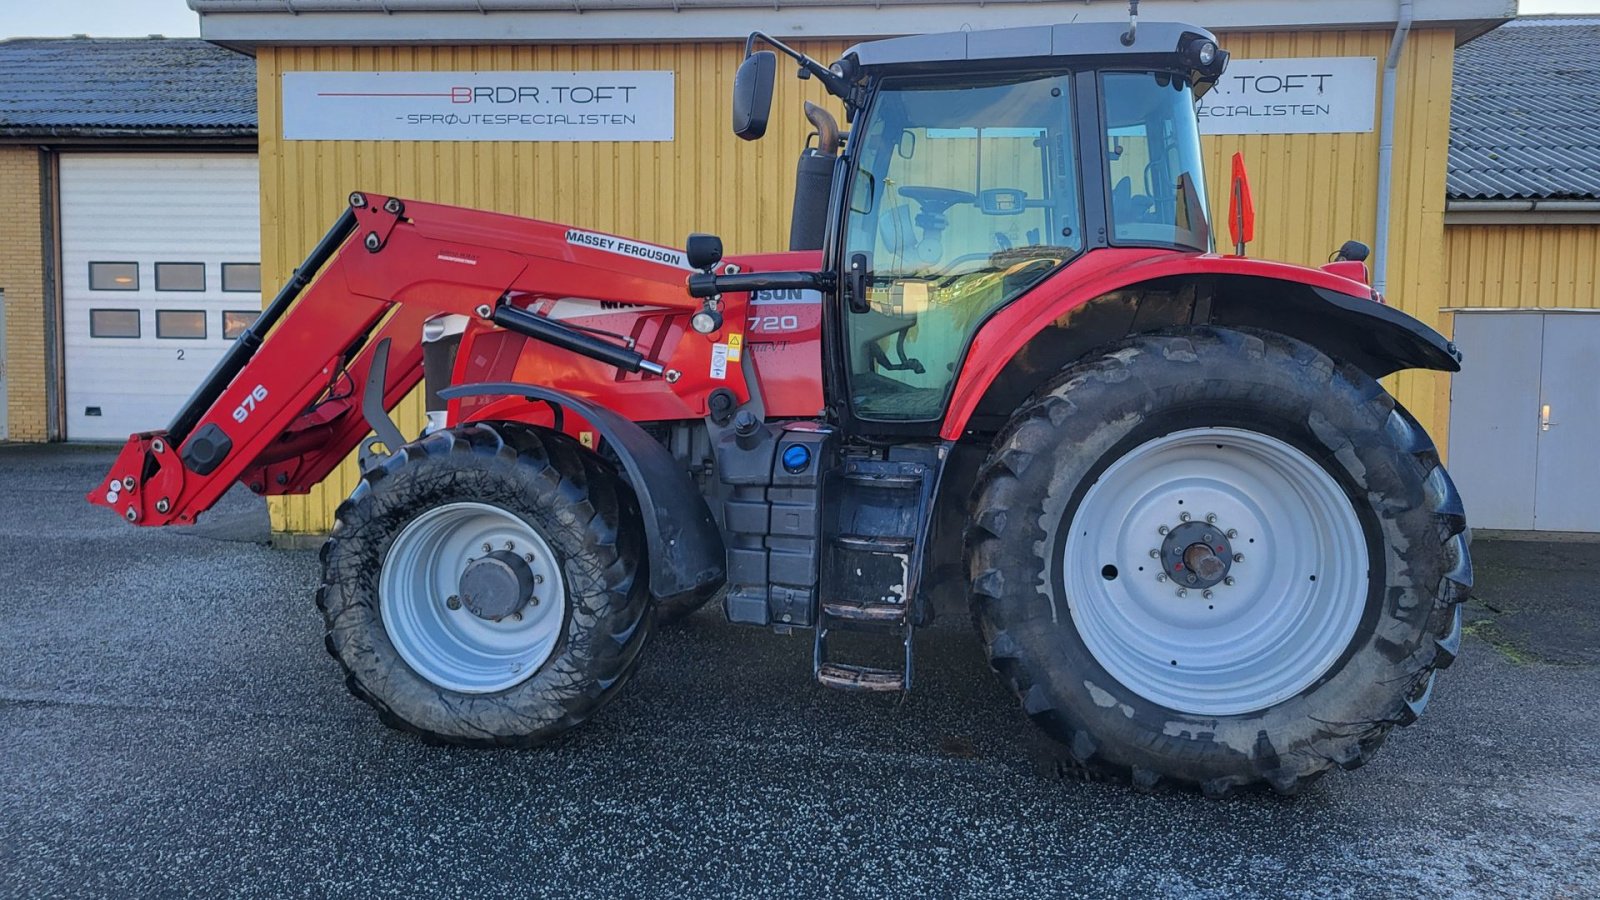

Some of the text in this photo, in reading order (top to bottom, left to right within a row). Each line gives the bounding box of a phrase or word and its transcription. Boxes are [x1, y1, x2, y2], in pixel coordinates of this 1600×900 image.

[451, 86, 637, 104] BRDR.TOFT
[566, 231, 681, 266] MASSEY FERGUSON
[176, 348, 185, 361] 2
[232, 384, 268, 424] 976
